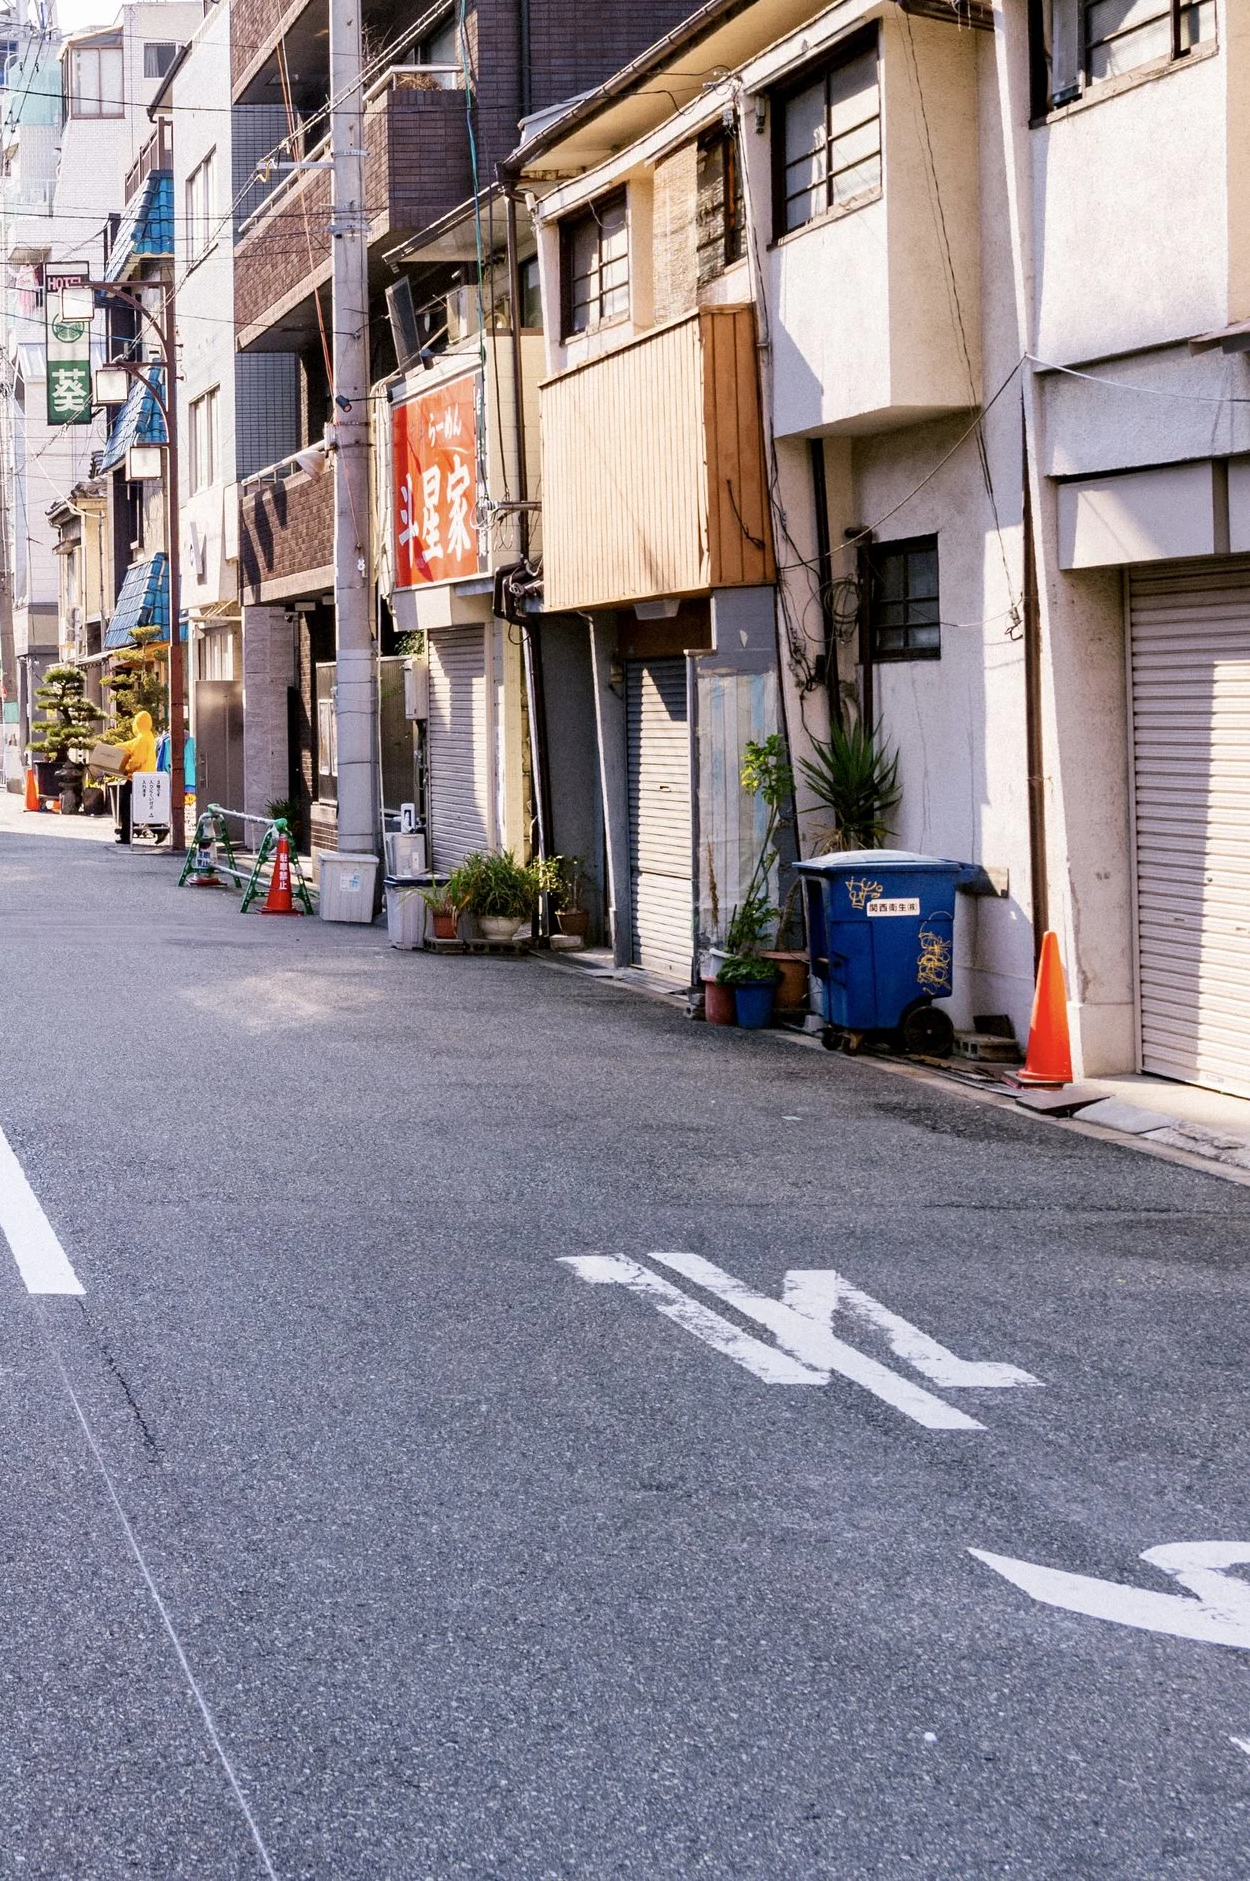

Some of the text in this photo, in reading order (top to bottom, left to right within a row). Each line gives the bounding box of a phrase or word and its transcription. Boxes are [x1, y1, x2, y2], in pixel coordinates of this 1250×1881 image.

[52, 368, 87, 412] 葵
[428, 403, 462, 447] らーめん
[399, 453, 471, 567] 斗星家
[279, 853, 288, 890] 駐車禁止
